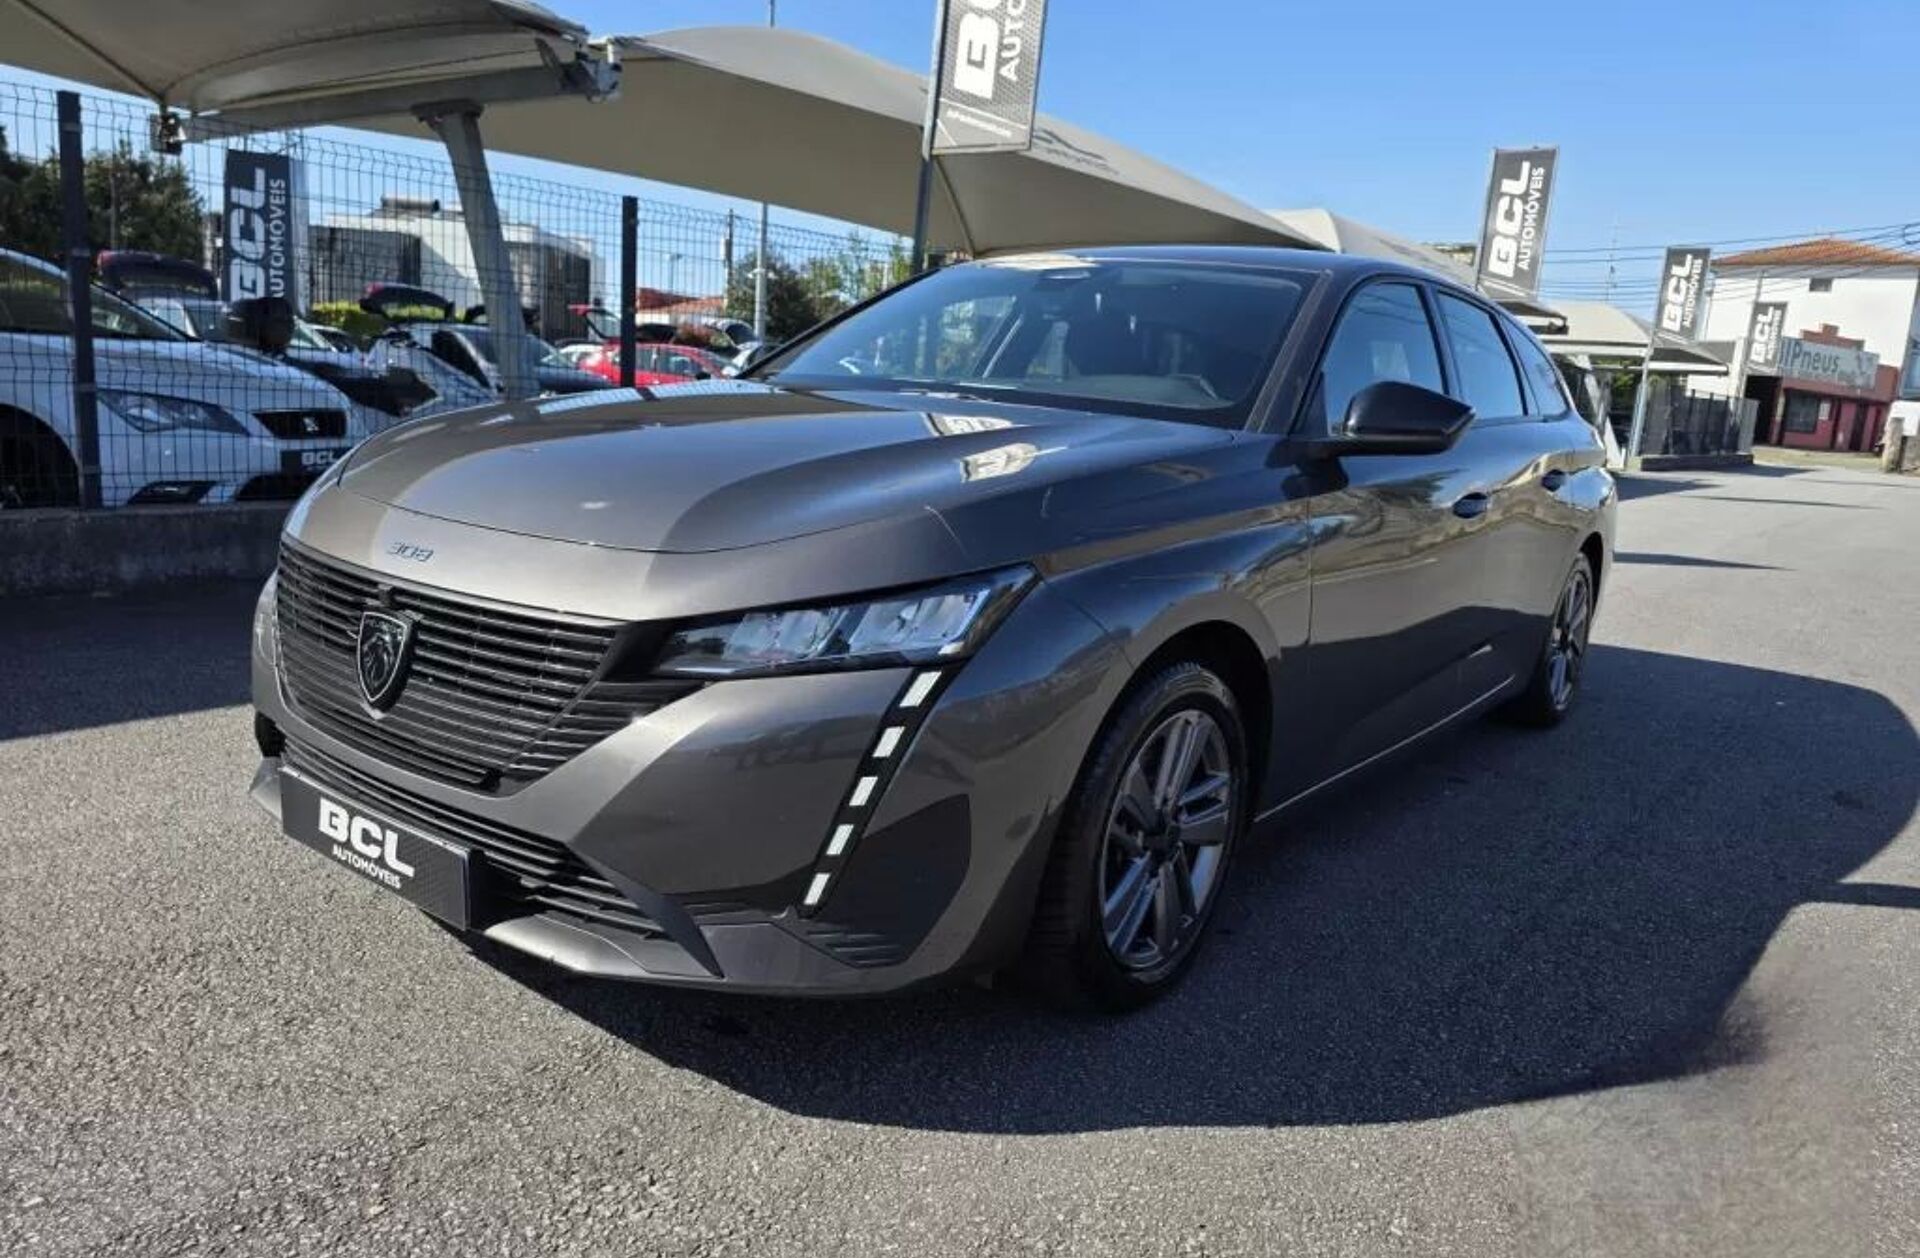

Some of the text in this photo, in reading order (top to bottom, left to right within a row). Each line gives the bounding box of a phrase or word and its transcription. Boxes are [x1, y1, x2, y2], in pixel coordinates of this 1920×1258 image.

[1488, 160, 1531, 278] BCL
[1517, 167, 1546, 270] AUTOMÓVEIS
[1662, 254, 1692, 332] BCL
[1750, 306, 1775, 363] BCL
[318, 796, 416, 878] BCL
[332, 843, 401, 889] AUTOMÓVEIS
